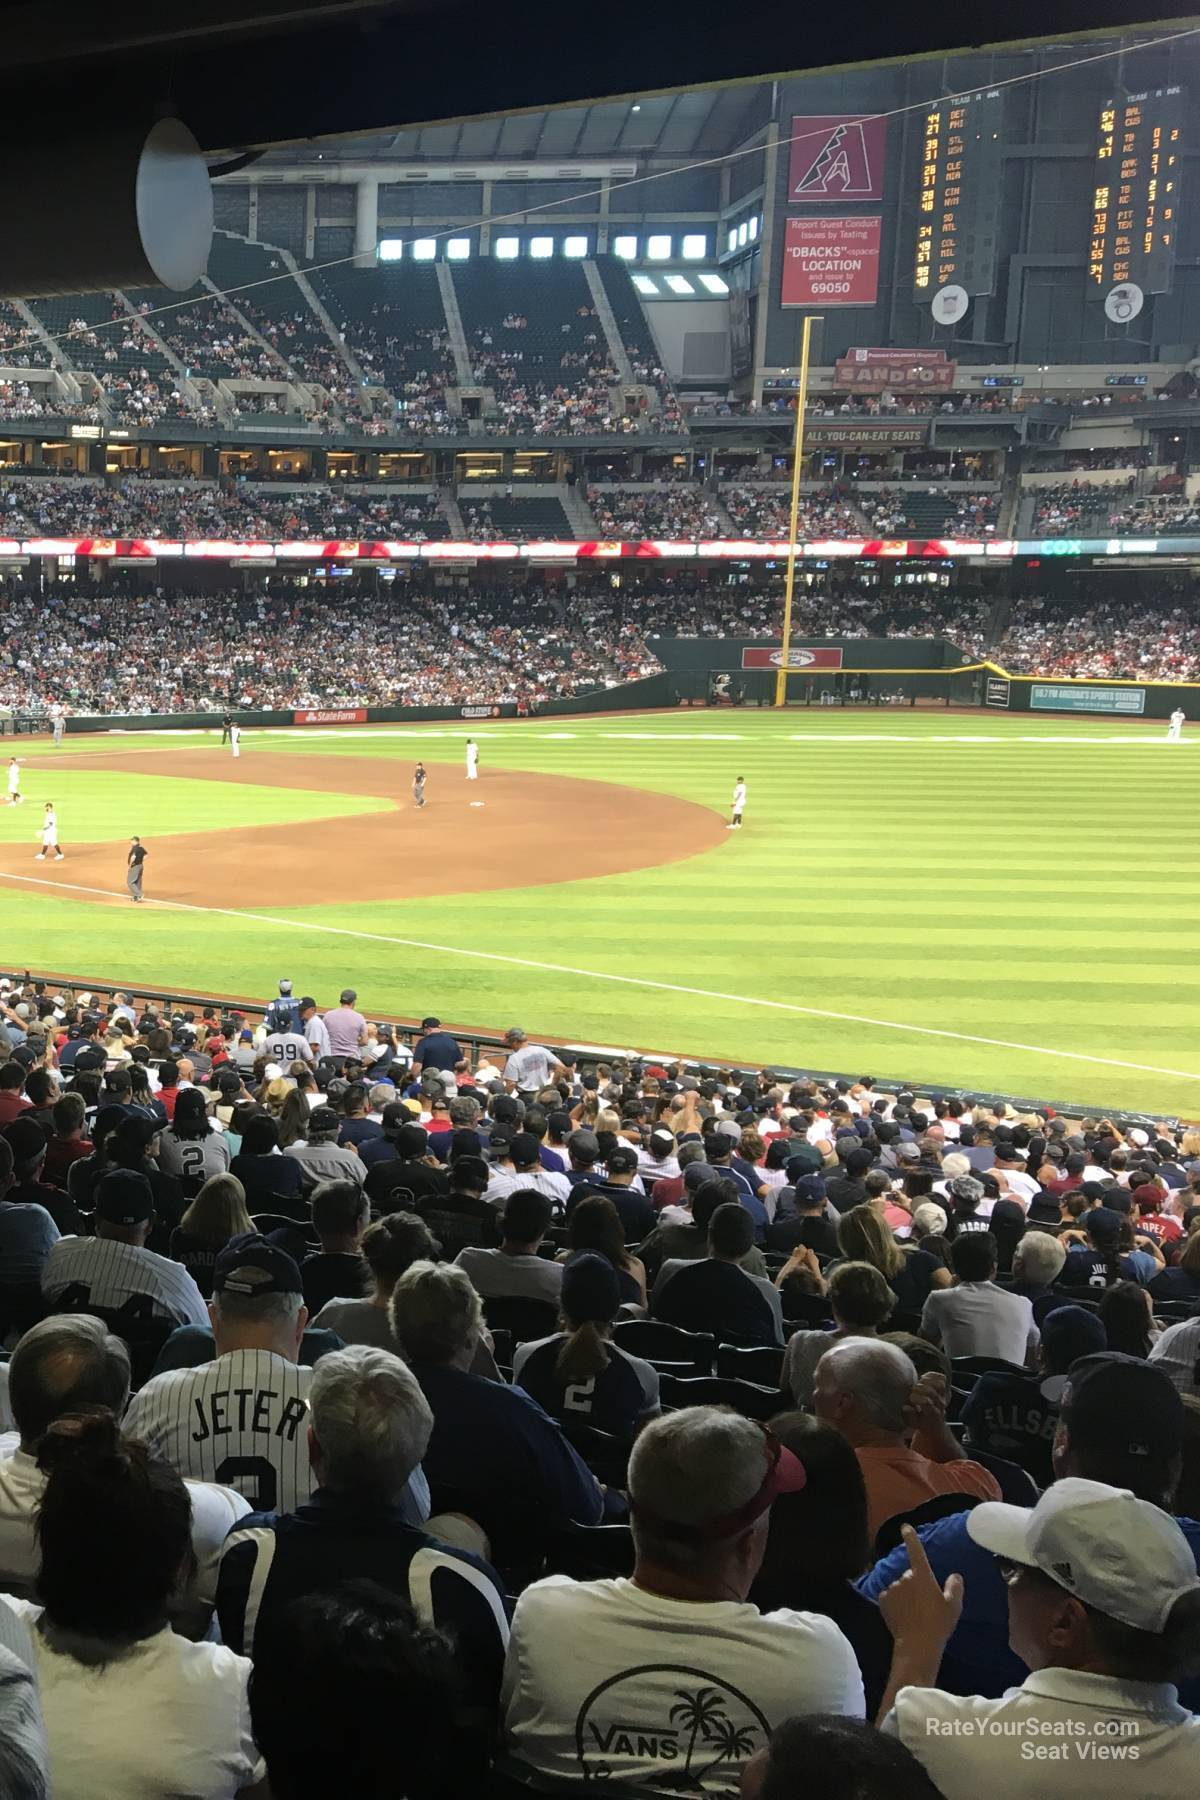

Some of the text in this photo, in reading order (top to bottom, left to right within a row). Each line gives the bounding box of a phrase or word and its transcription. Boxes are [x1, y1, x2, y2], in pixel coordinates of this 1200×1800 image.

[927, 124, 939, 135] 27
[1171, 130, 1178, 140] 2
[802, 260, 862, 271] LOCATION
[811, 282, 850, 294] 69050
[806, 430, 921, 441] ALL-YOU-CAN-EAT SEATS
[1041, 540, 1082, 555] COX
[273, 1043, 297, 1061] 99
[182, 1146, 205, 1180] 2
[192, 1389, 308, 1442] JETER
[588, 1721, 679, 1760] VANS
